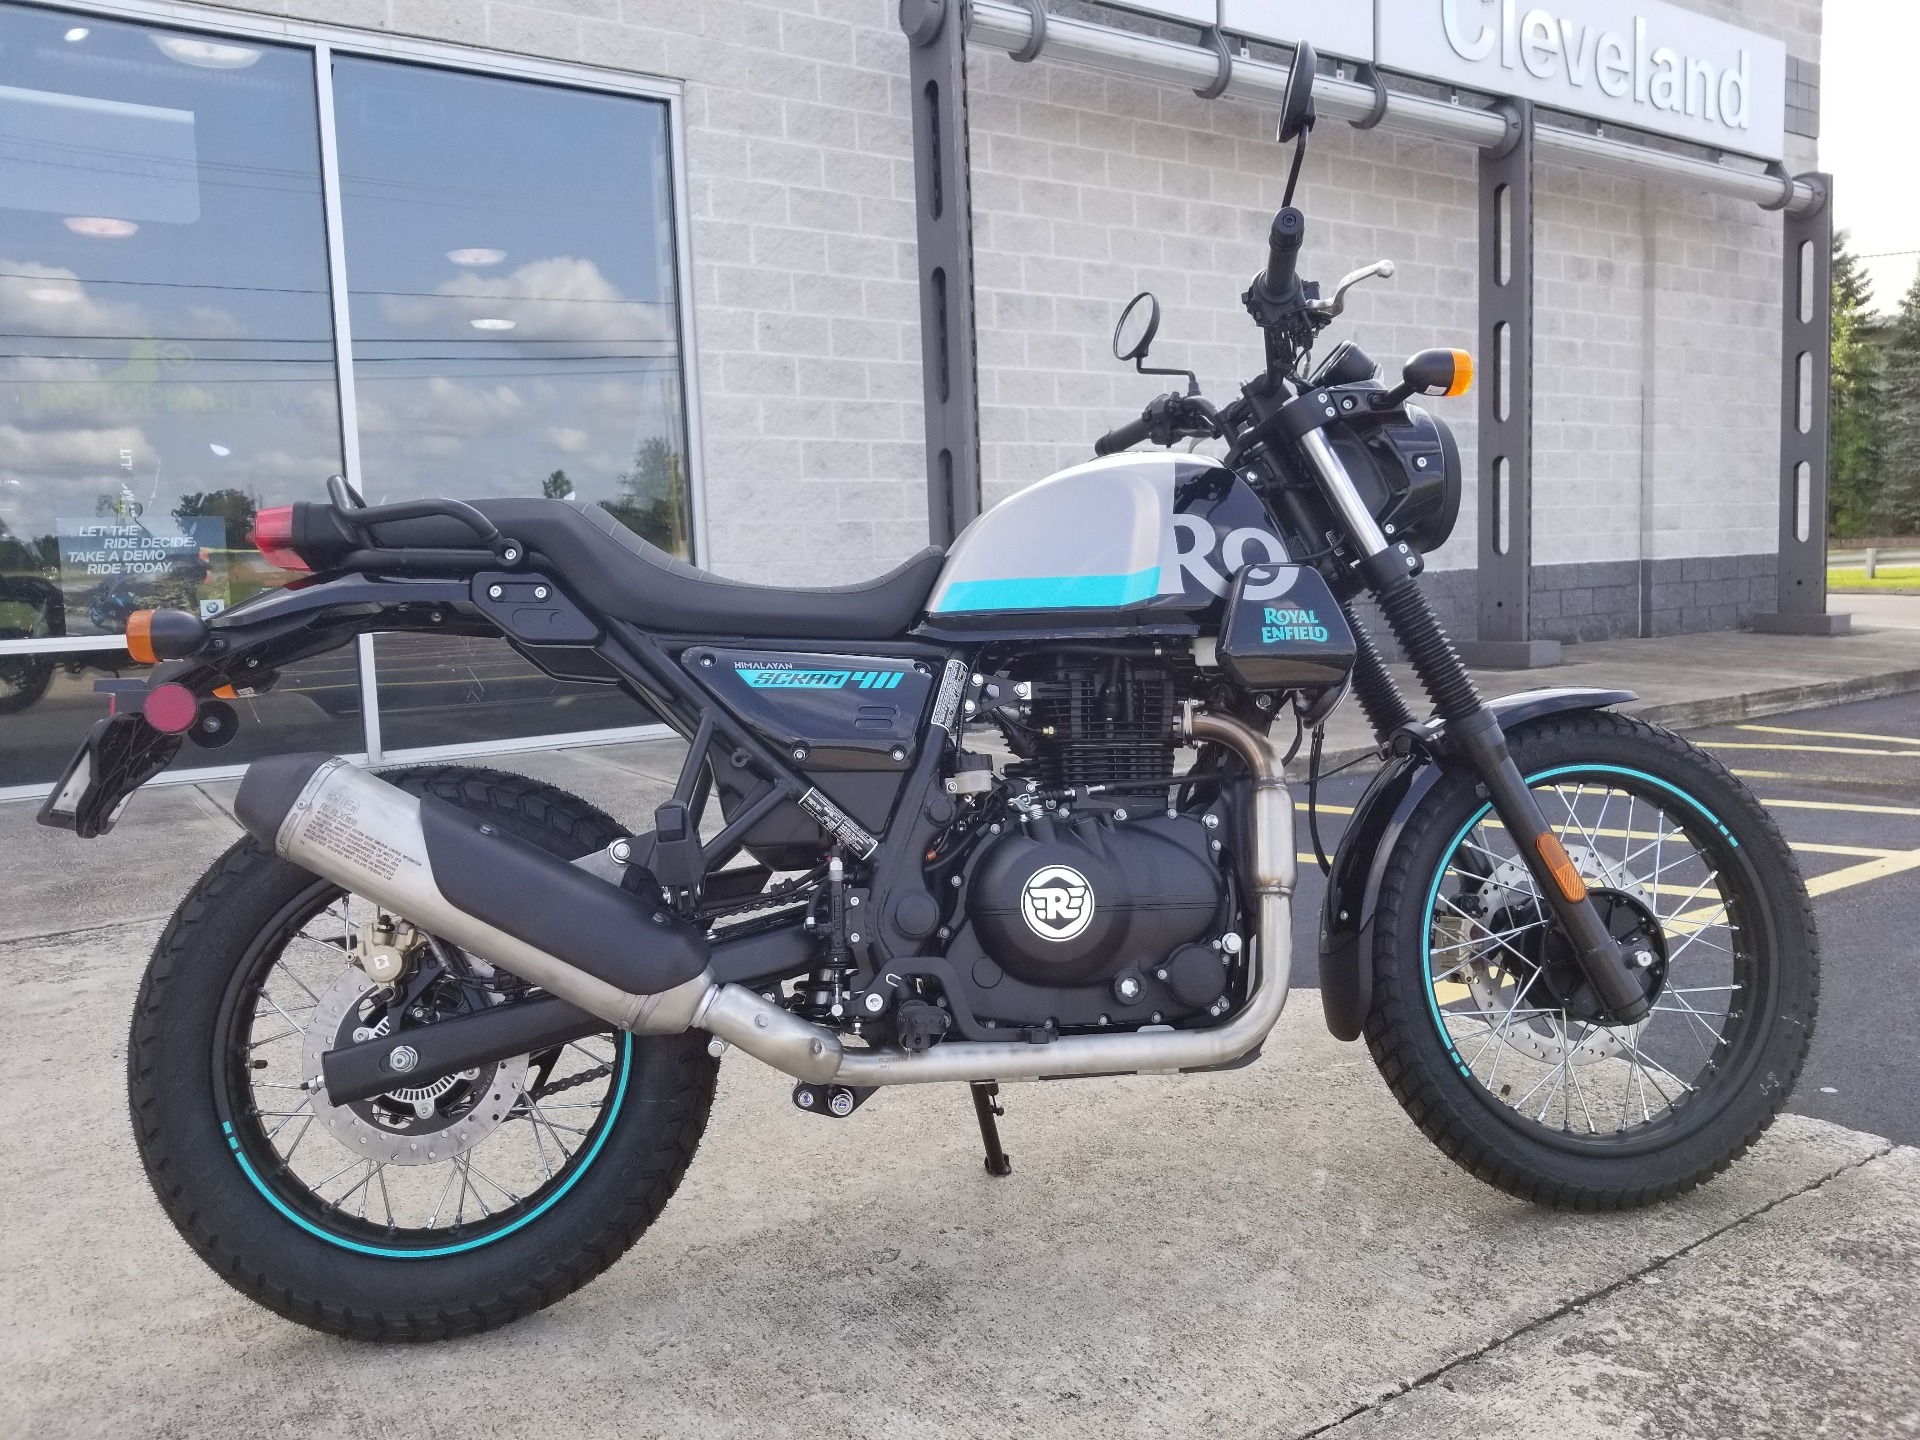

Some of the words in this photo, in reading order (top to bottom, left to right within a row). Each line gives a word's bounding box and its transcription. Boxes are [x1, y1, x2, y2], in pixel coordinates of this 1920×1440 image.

[1441, 0, 1748, 130] Cleveland
[79, 525, 107, 537] LET
[110, 525, 139, 536] THE
[103, 538, 138, 549] RIDE
[140, 536, 196, 548] DECIDE.
[68, 551, 106, 562] TAKE
[107, 550, 119, 561] A
[122, 549, 166, 561] DEMO
[86, 563, 121, 574] RIDE
[124, 561, 173, 574] TODAY.
[1263, 607, 1319, 626] ROYAL
[1261, 626, 1328, 644] ENFIELD
[734, 661, 793, 670] HIMALAYAN
[752, 671, 845, 686] SCRAM
[850, 671, 905, 689] 411
